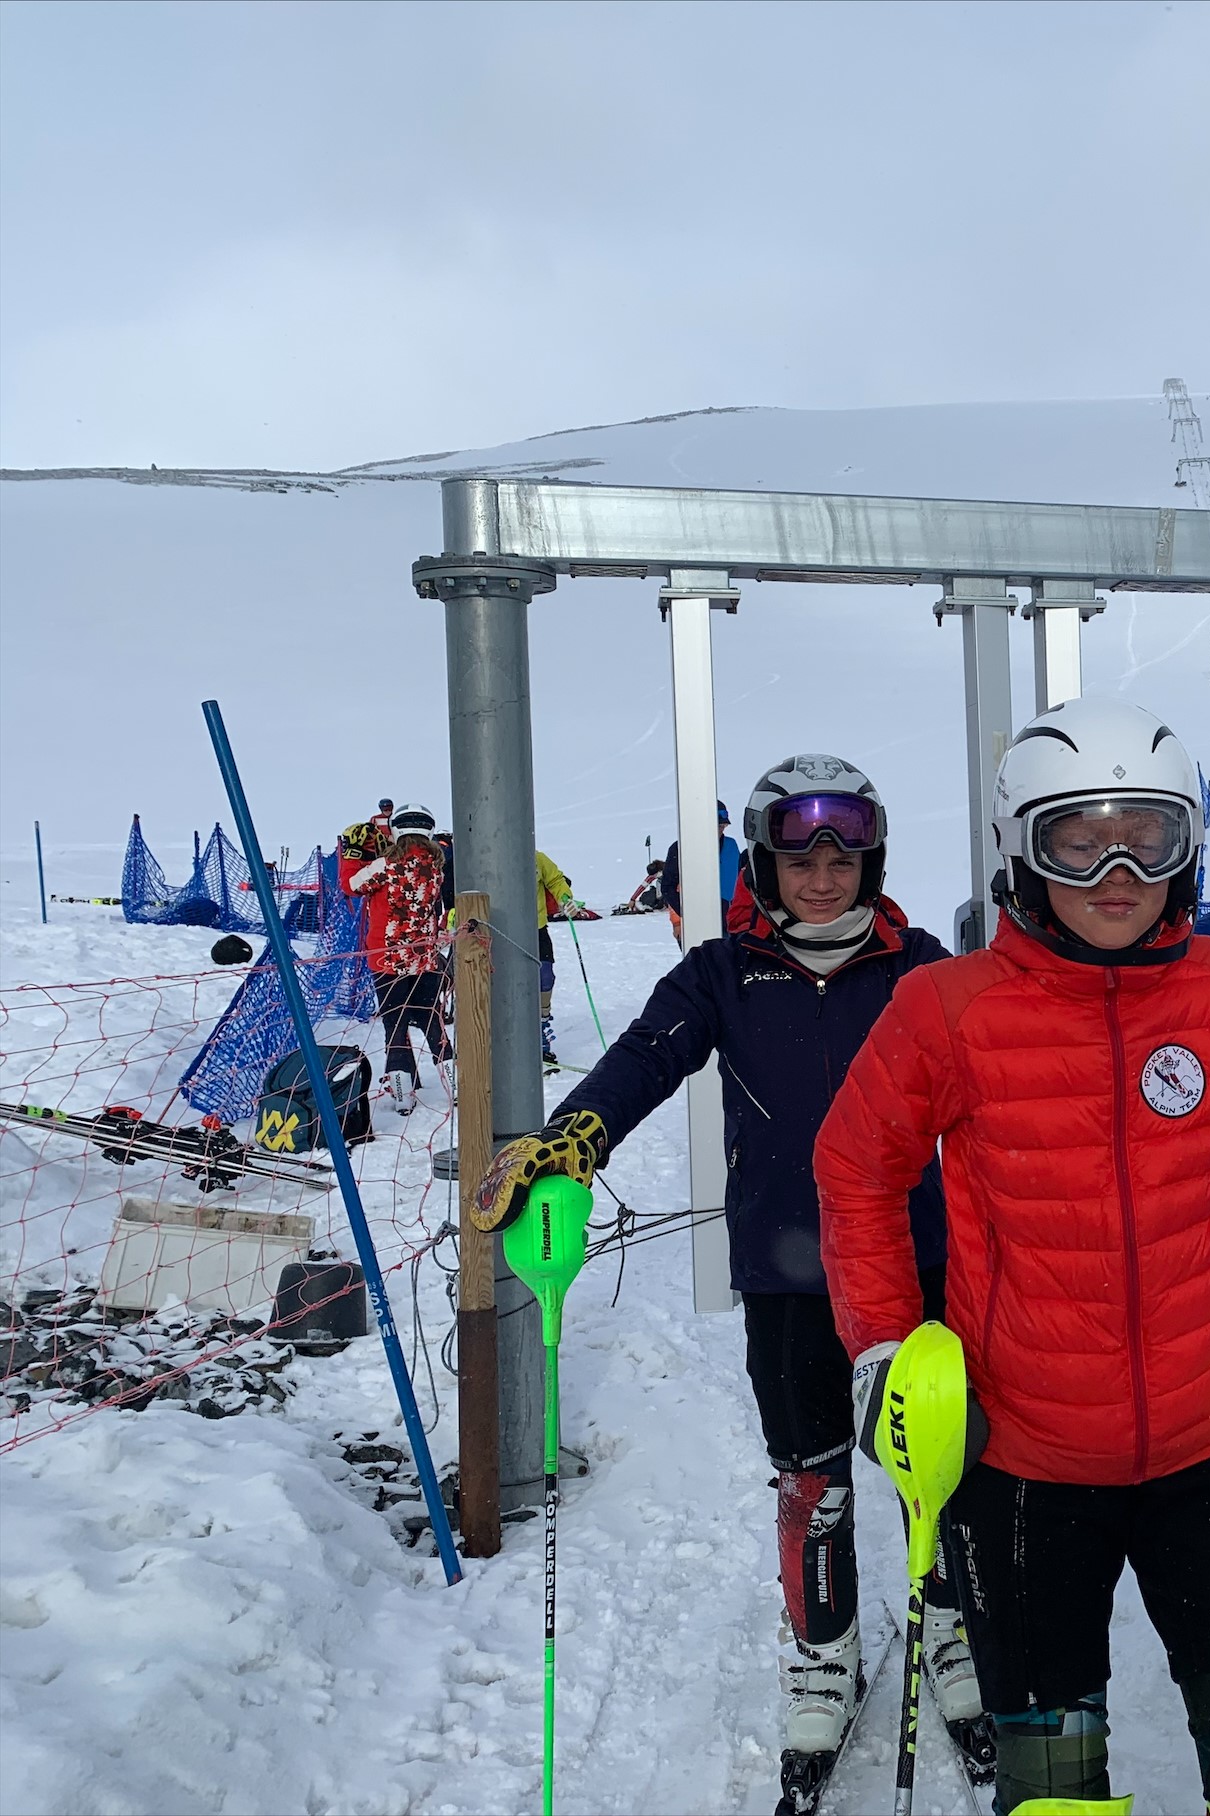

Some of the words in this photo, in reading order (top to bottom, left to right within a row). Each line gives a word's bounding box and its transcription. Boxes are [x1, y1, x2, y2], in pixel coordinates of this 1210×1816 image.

[743, 970, 793, 985] phenix
[1144, 1048, 1168, 1087] POCKET
[1172, 1047, 1202, 1078] VALLEY
[1149, 1097, 1176, 1114] ALPIN
[1180, 1088, 1201, 1112] TEAM
[541, 1202, 552, 1261] KOMPERDELL
[889, 1390, 912, 1473] LEKI
[545, 1490, 558, 1629] KOMPERDELL
[817, 1546, 829, 1603] ENERGIAPURA
[959, 1523, 985, 1612] phenix
